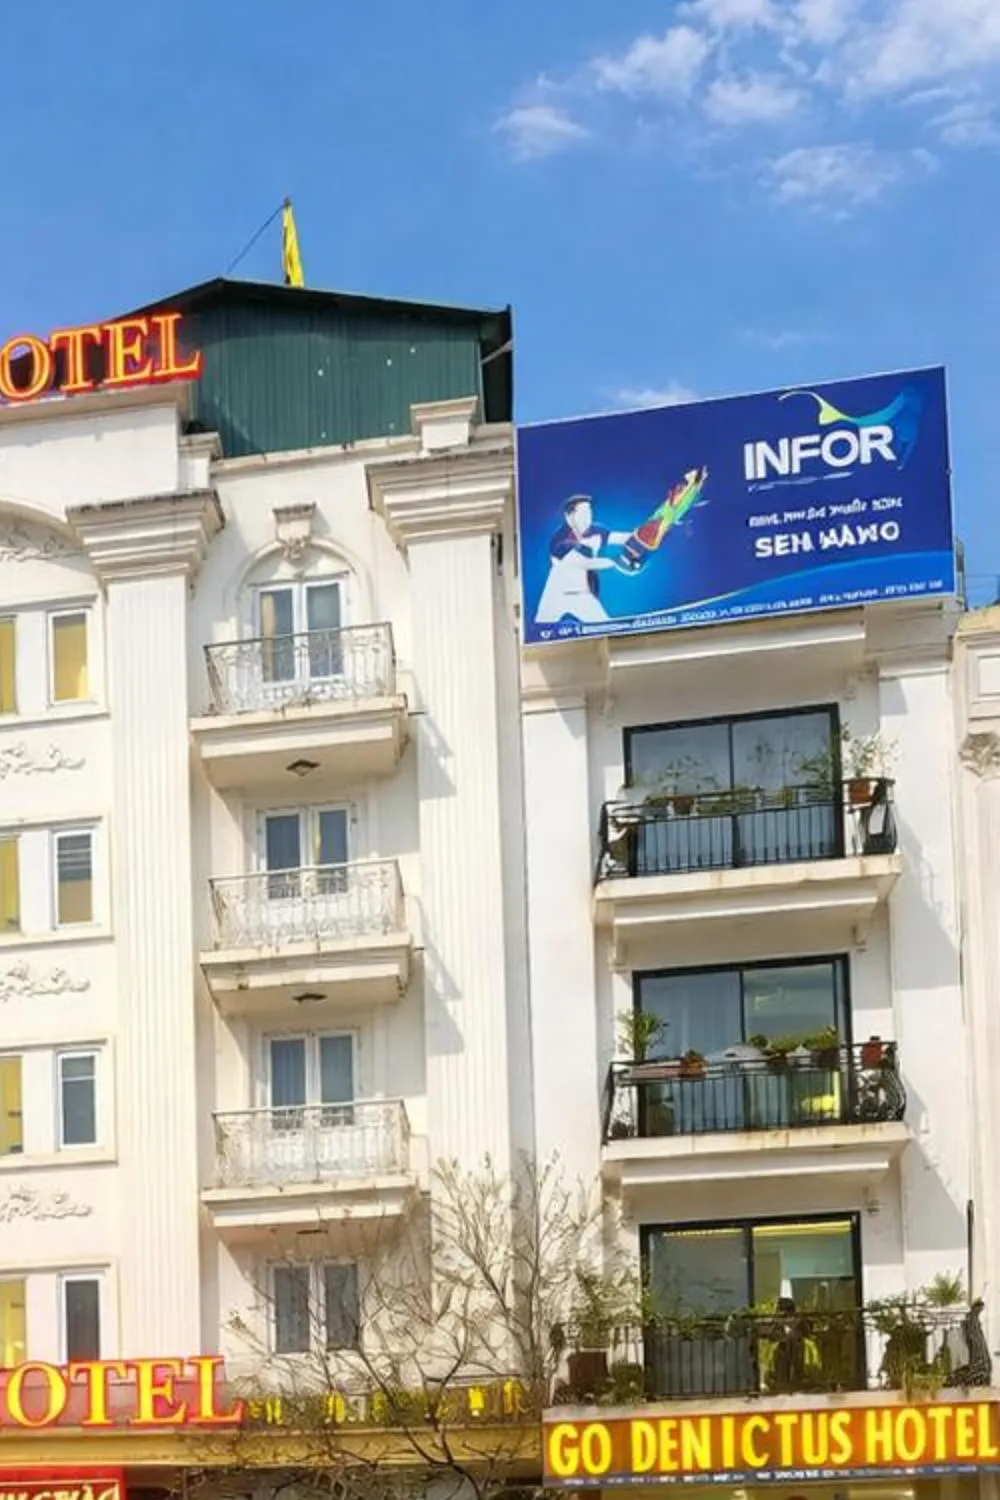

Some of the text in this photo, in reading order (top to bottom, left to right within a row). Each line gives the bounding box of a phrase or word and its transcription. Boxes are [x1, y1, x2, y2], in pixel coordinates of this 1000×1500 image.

[744, 424, 897, 481] INFOR
[549, 1422, 612, 1476] GO
[865, 1403, 998, 1463] HOTEL
